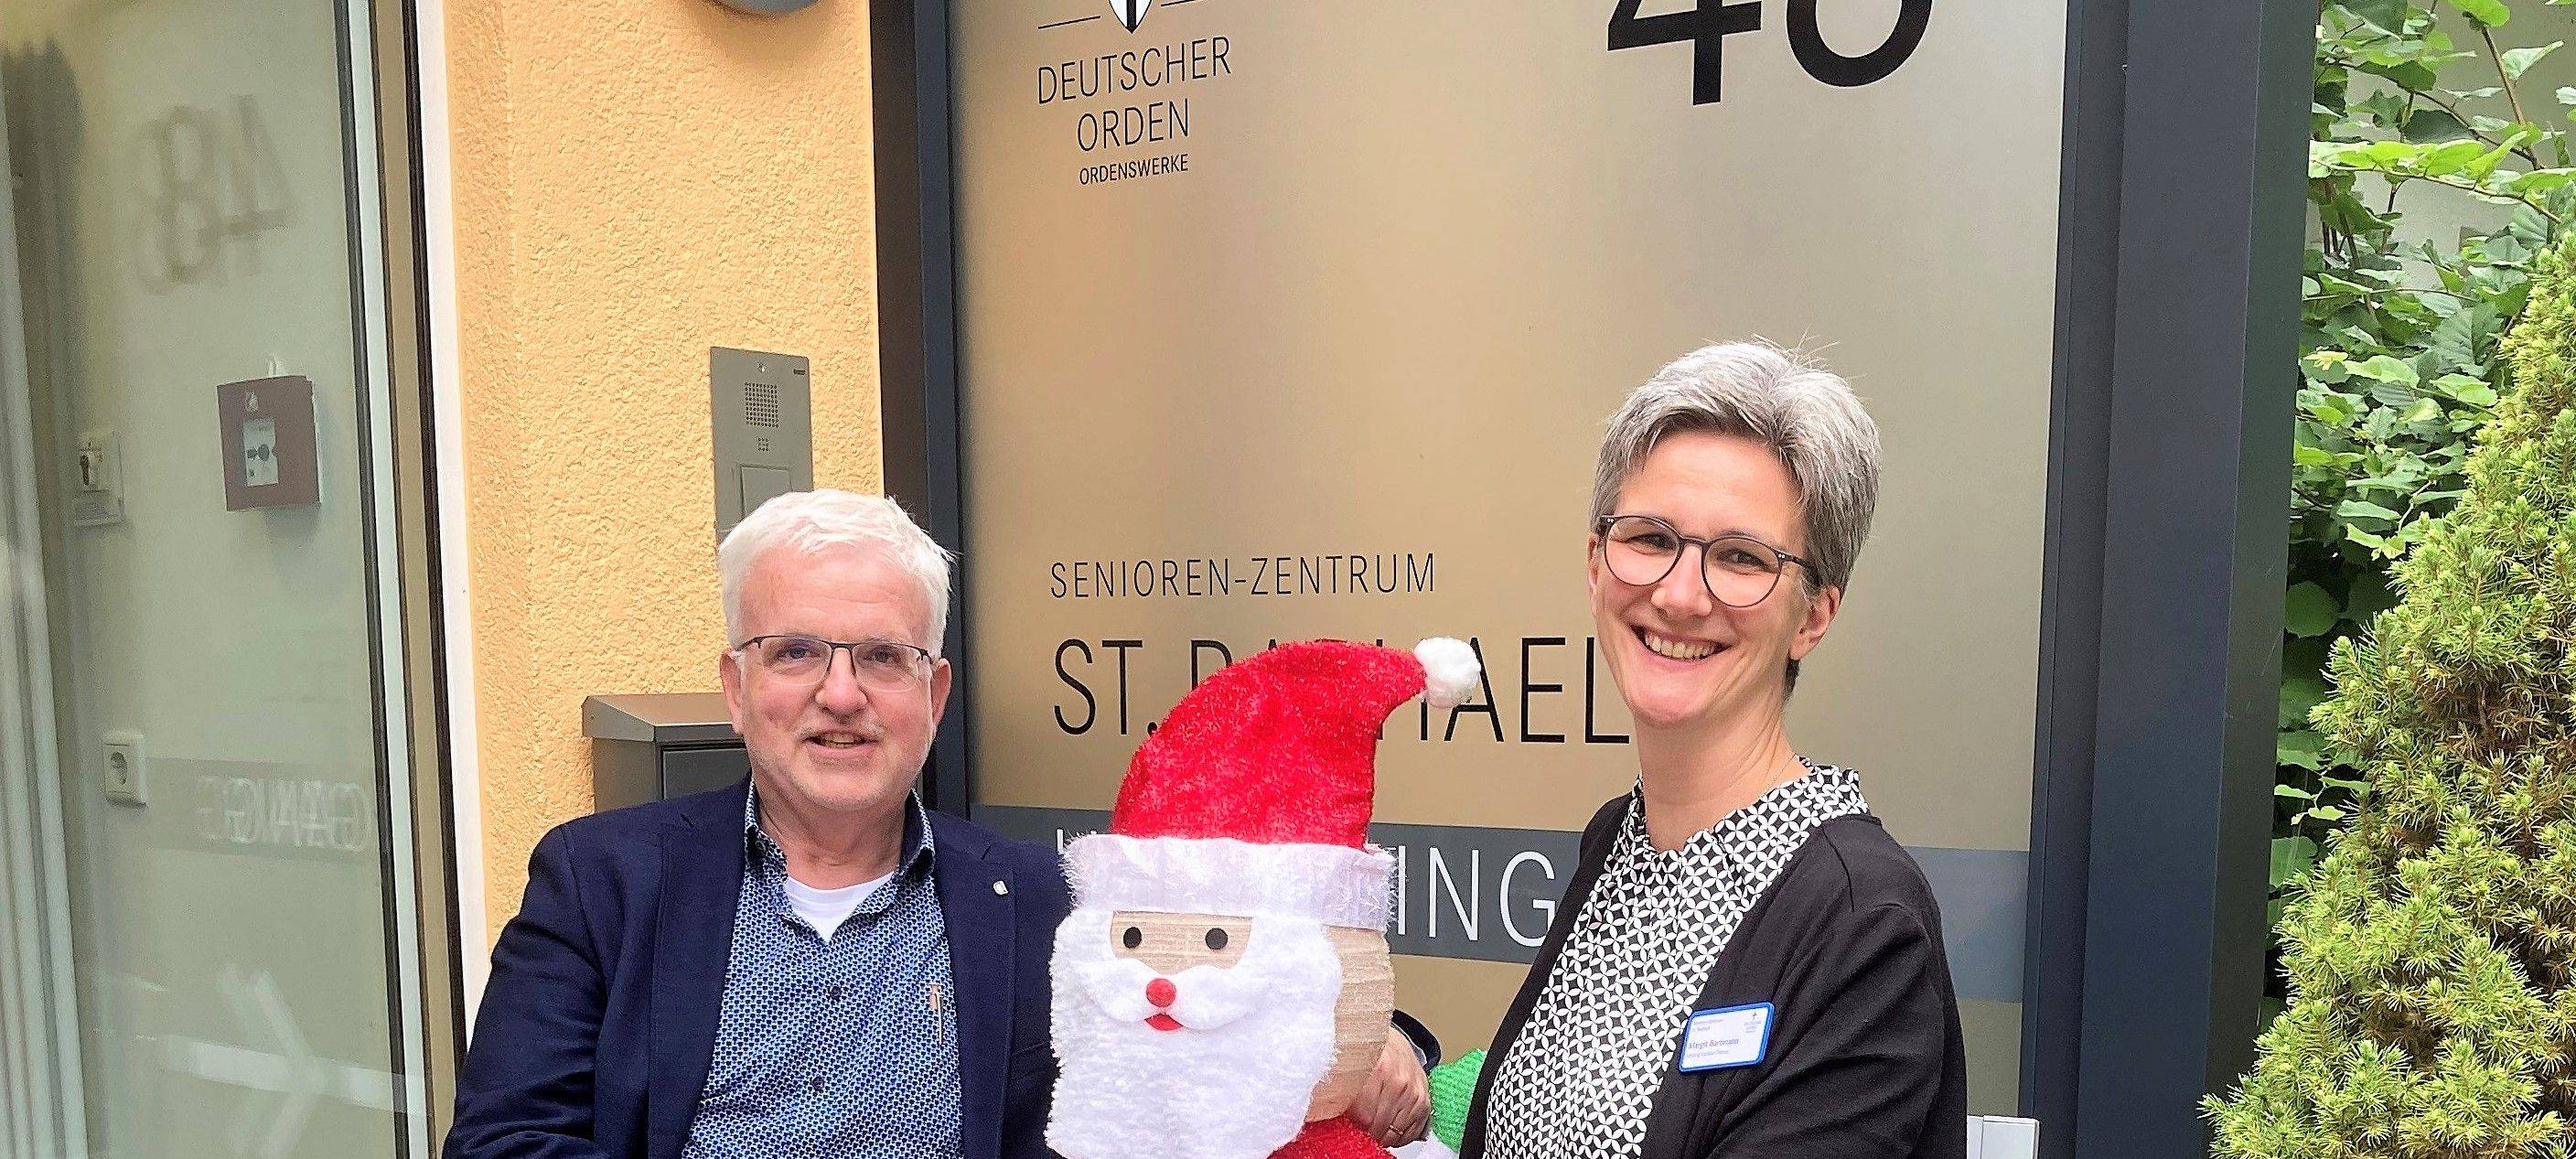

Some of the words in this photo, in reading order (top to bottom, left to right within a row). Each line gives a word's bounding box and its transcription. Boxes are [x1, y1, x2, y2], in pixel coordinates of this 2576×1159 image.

[1037, 36, 1231, 104] DEUTSCHER
[1077, 98, 1188, 152] ORDEN
[1079, 154, 1188, 185] ORDENSWERKE
[1050, 553, 1435, 598] SENIOREN-ZENTRUM
